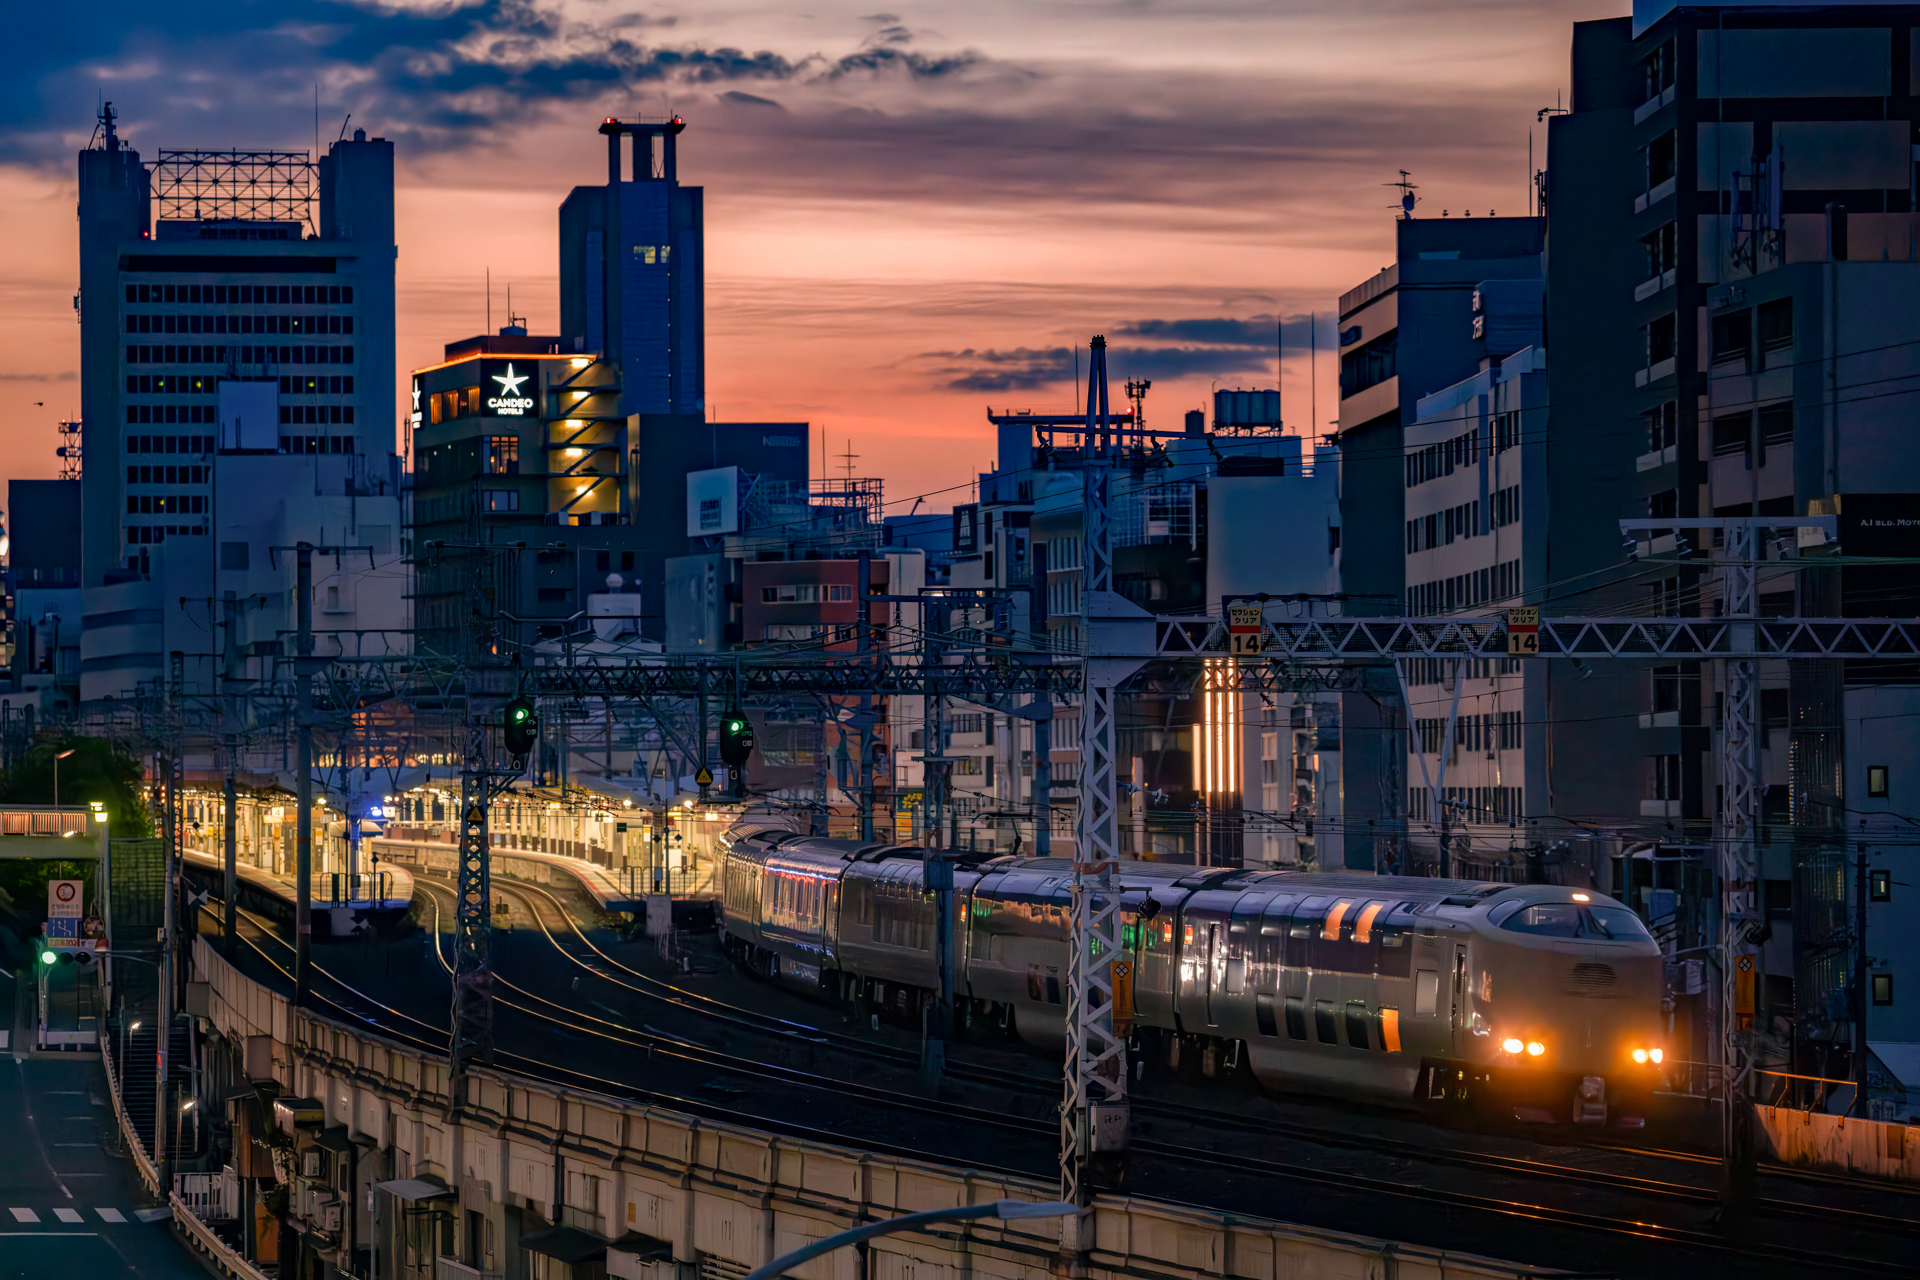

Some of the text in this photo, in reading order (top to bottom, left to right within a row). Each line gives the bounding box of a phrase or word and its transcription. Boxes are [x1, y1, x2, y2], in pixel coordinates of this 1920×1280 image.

[487, 397, 534, 409] CANDEO
[497, 407, 524, 415] HOTELS
[1509, 608, 1537, 616] セクション
[1234, 635, 1259, 653] 14
[1512, 634, 1537, 652] 14
